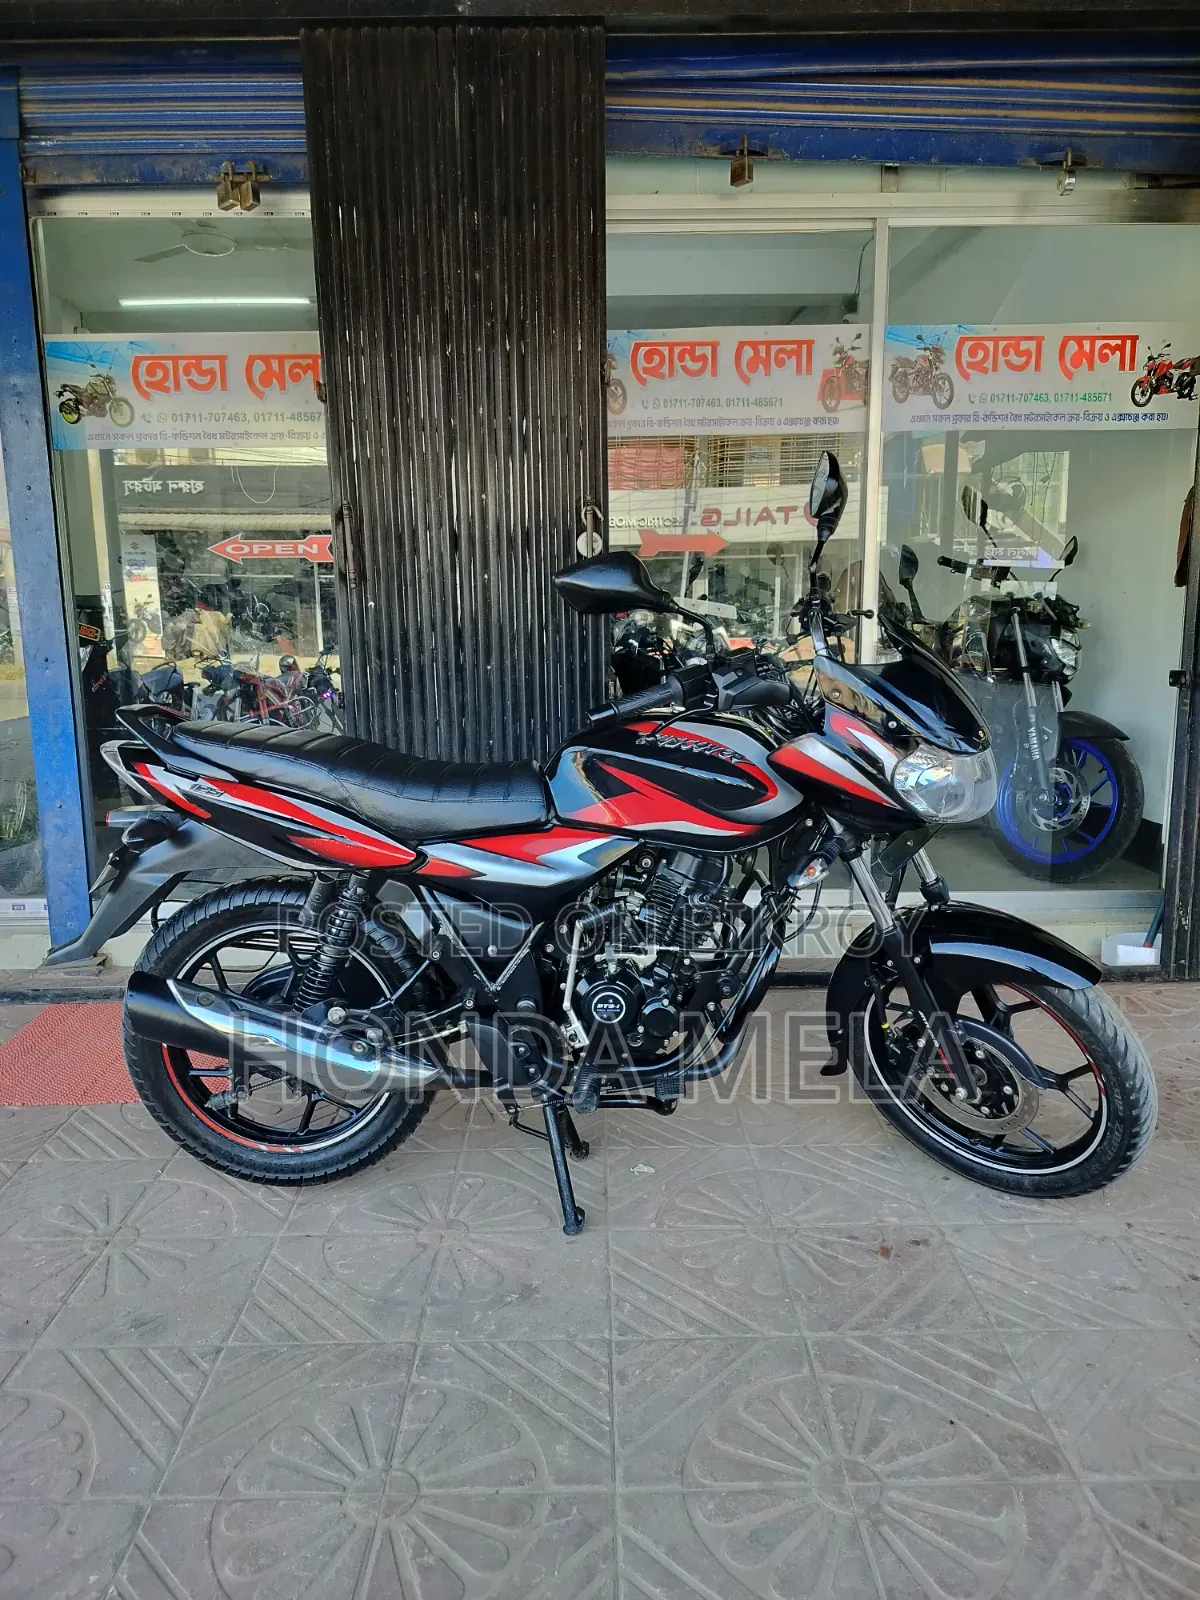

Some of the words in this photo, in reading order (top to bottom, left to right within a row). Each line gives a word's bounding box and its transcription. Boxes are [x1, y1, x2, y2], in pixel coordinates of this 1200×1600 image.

[630, 340, 719, 387] হোন্ডা
[734, 339, 815, 386] মেলা
[955, 335, 1045, 382] হোন্ডা
[1058, 334, 1140, 381] মেলা
[131, 354, 228, 400] হোন্ডা
[244, 354, 322, 400] মেল
[663, 398, 724, 409] 01711-707463,
[725, 397, 783, 408] 01711-485671
[1054, 392, 1112, 403] 01711-485671
[172, 412, 250, 424] 01711-707463,
[225, 544, 318, 554] OPEN
[1027, 726, 1040, 761] YAMAHA
